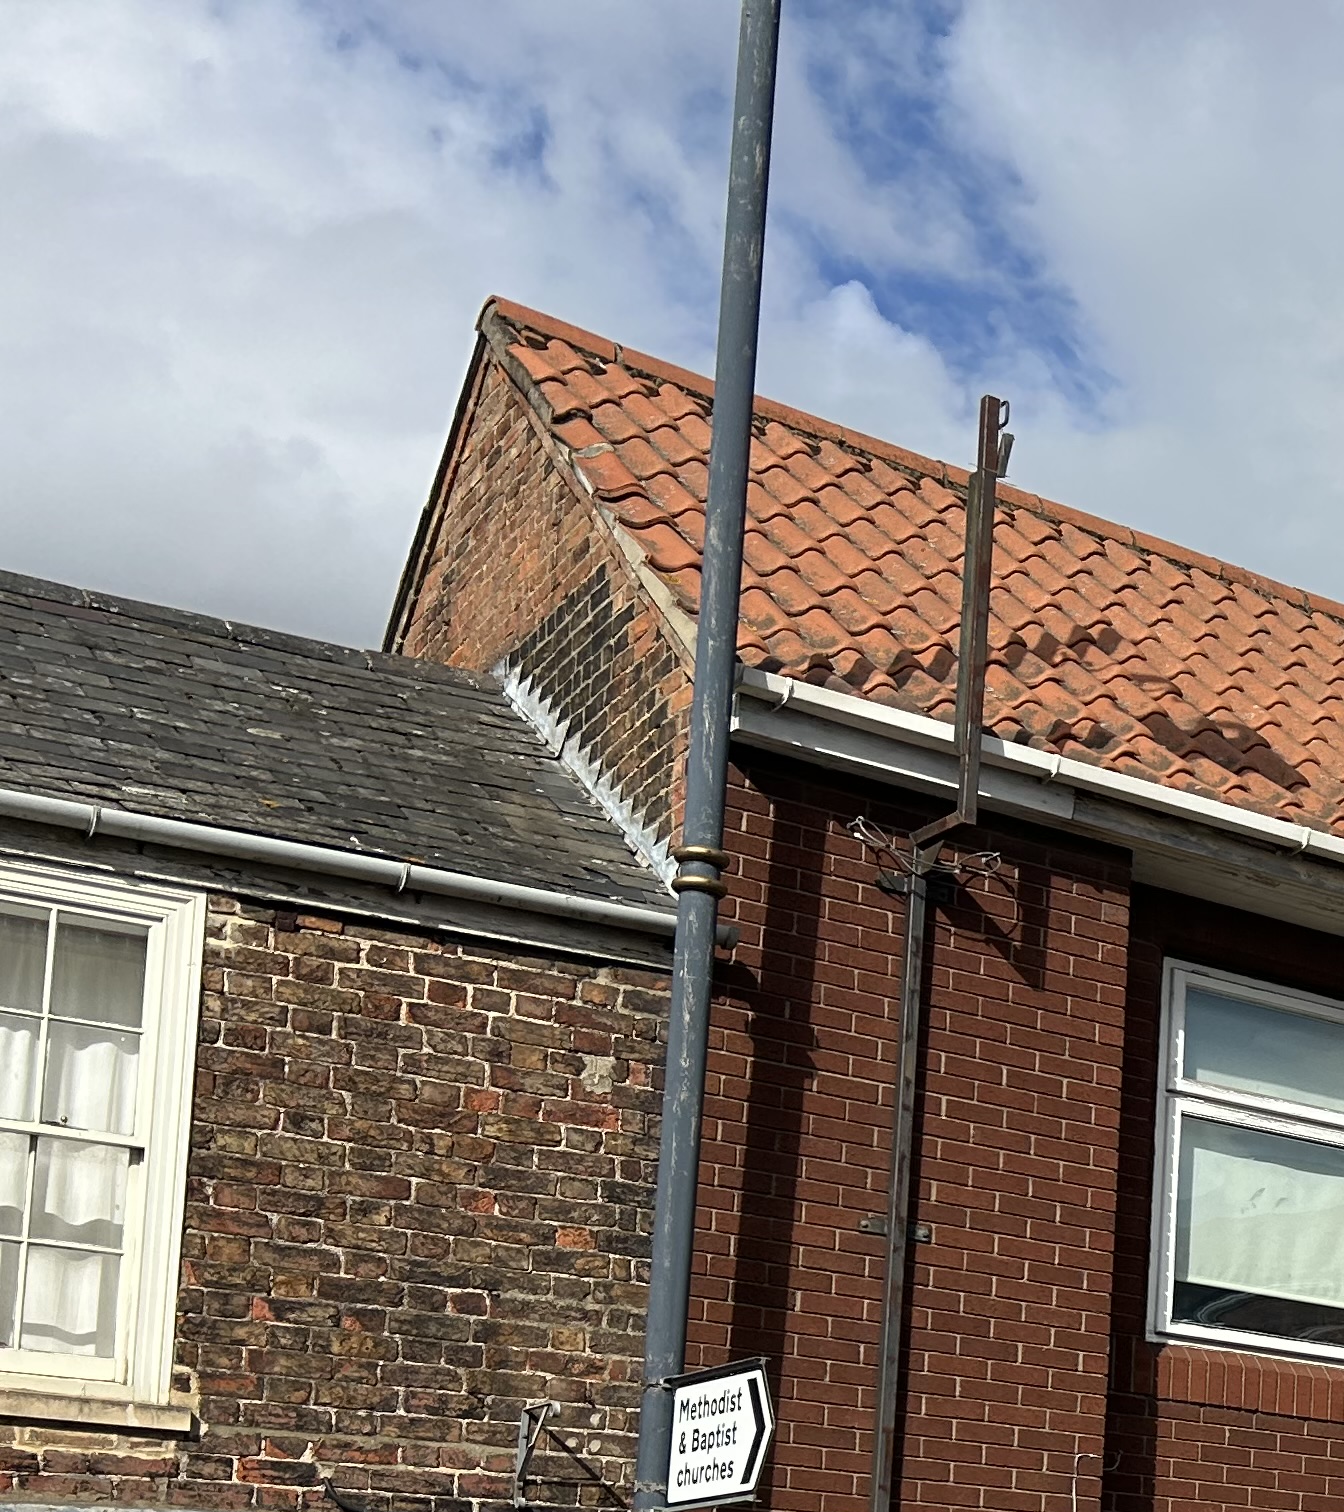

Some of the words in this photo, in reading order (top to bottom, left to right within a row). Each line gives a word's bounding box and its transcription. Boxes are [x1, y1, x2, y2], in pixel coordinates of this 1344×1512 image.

[678, 1387, 743, 1423] Methodist
[678, 1431, 687, 1454] &
[691, 1421, 738, 1454] Baptist
[677, 1457, 734, 1487] churches
